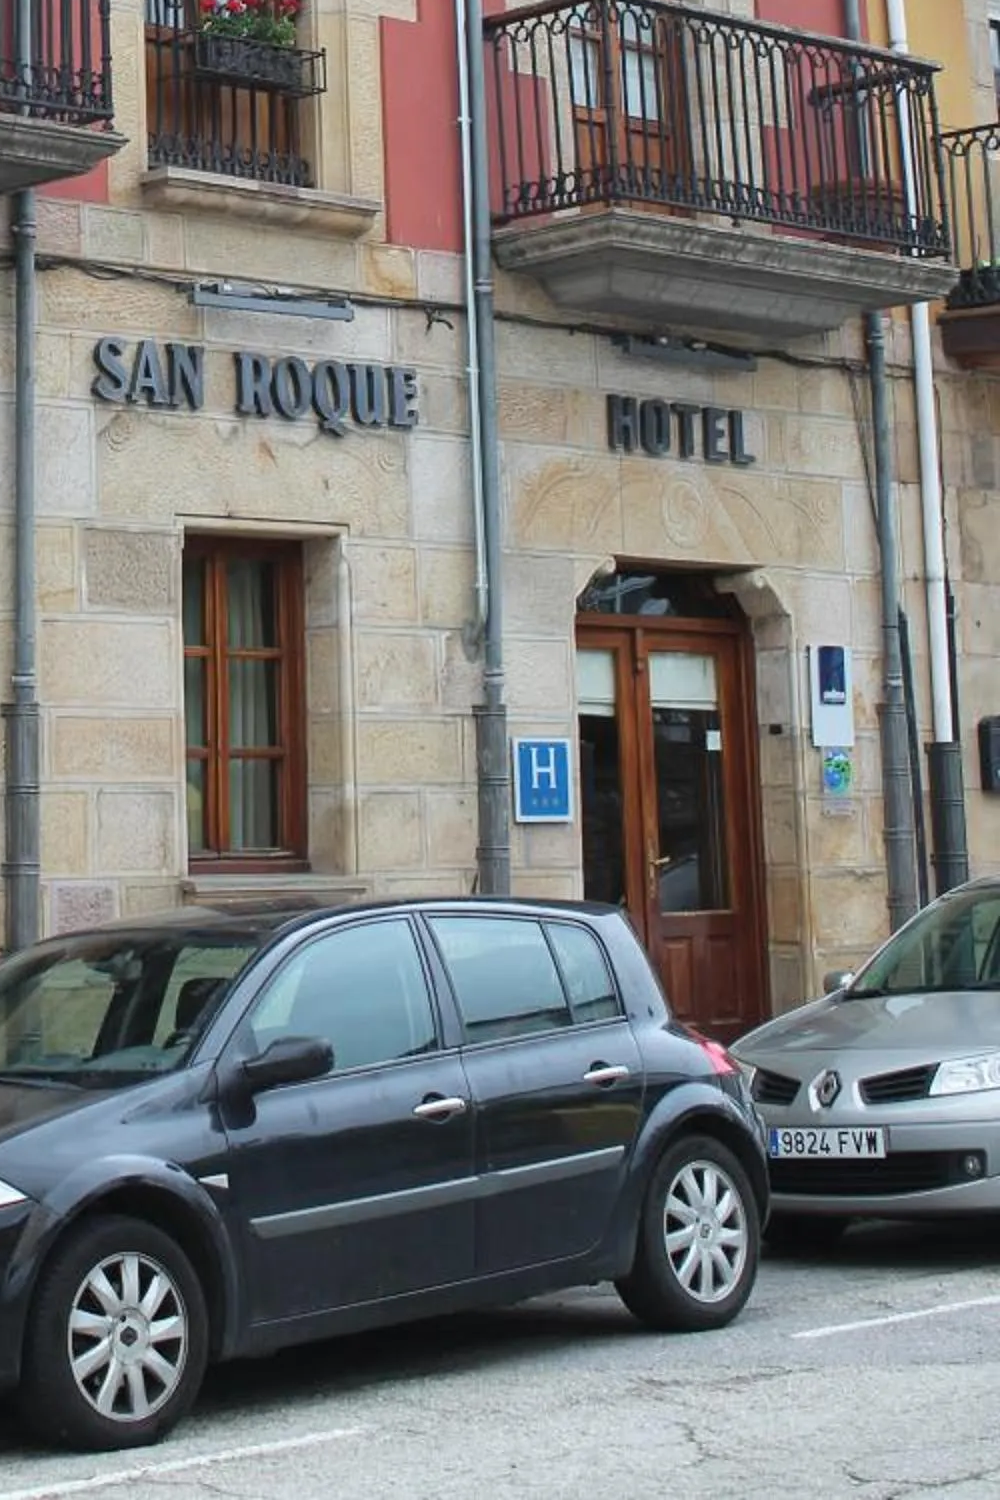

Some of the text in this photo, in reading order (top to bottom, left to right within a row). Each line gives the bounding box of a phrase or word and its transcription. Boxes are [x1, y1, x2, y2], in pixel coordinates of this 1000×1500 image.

[91, 336, 419, 436] SAN ROQUE
[606, 393, 756, 465] HOTEL
[530, 747, 557, 789] H
[781, 1130, 878, 1155] 9824 FVW
